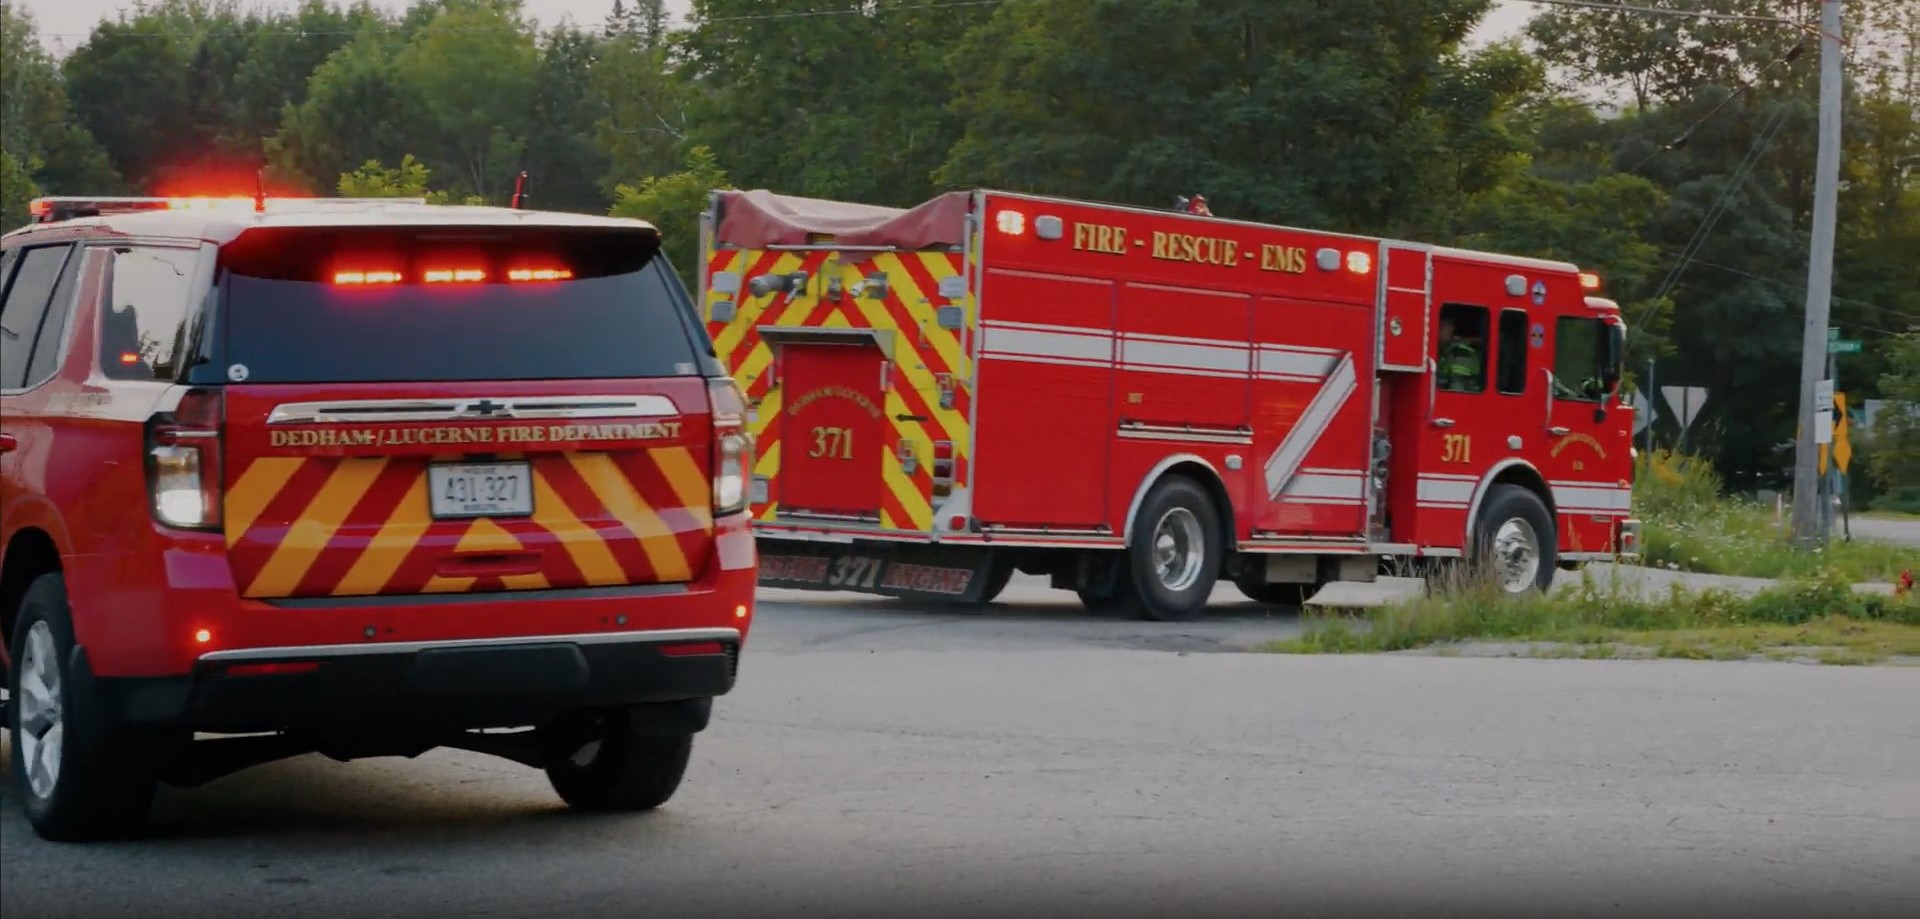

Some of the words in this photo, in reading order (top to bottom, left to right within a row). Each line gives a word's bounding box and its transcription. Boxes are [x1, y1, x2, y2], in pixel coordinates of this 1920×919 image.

[1073, 222, 1127, 254] FIRE
[1152, 231, 1238, 266] RESCUE
[1260, 244, 1306, 274] EMS
[496, 426, 546, 443] FIRE
[549, 423, 682, 442] DEPARTMENT
[808, 426, 854, 459] 371
[1441, 434, 1471, 463] 371
[828, 556, 884, 587] 371
